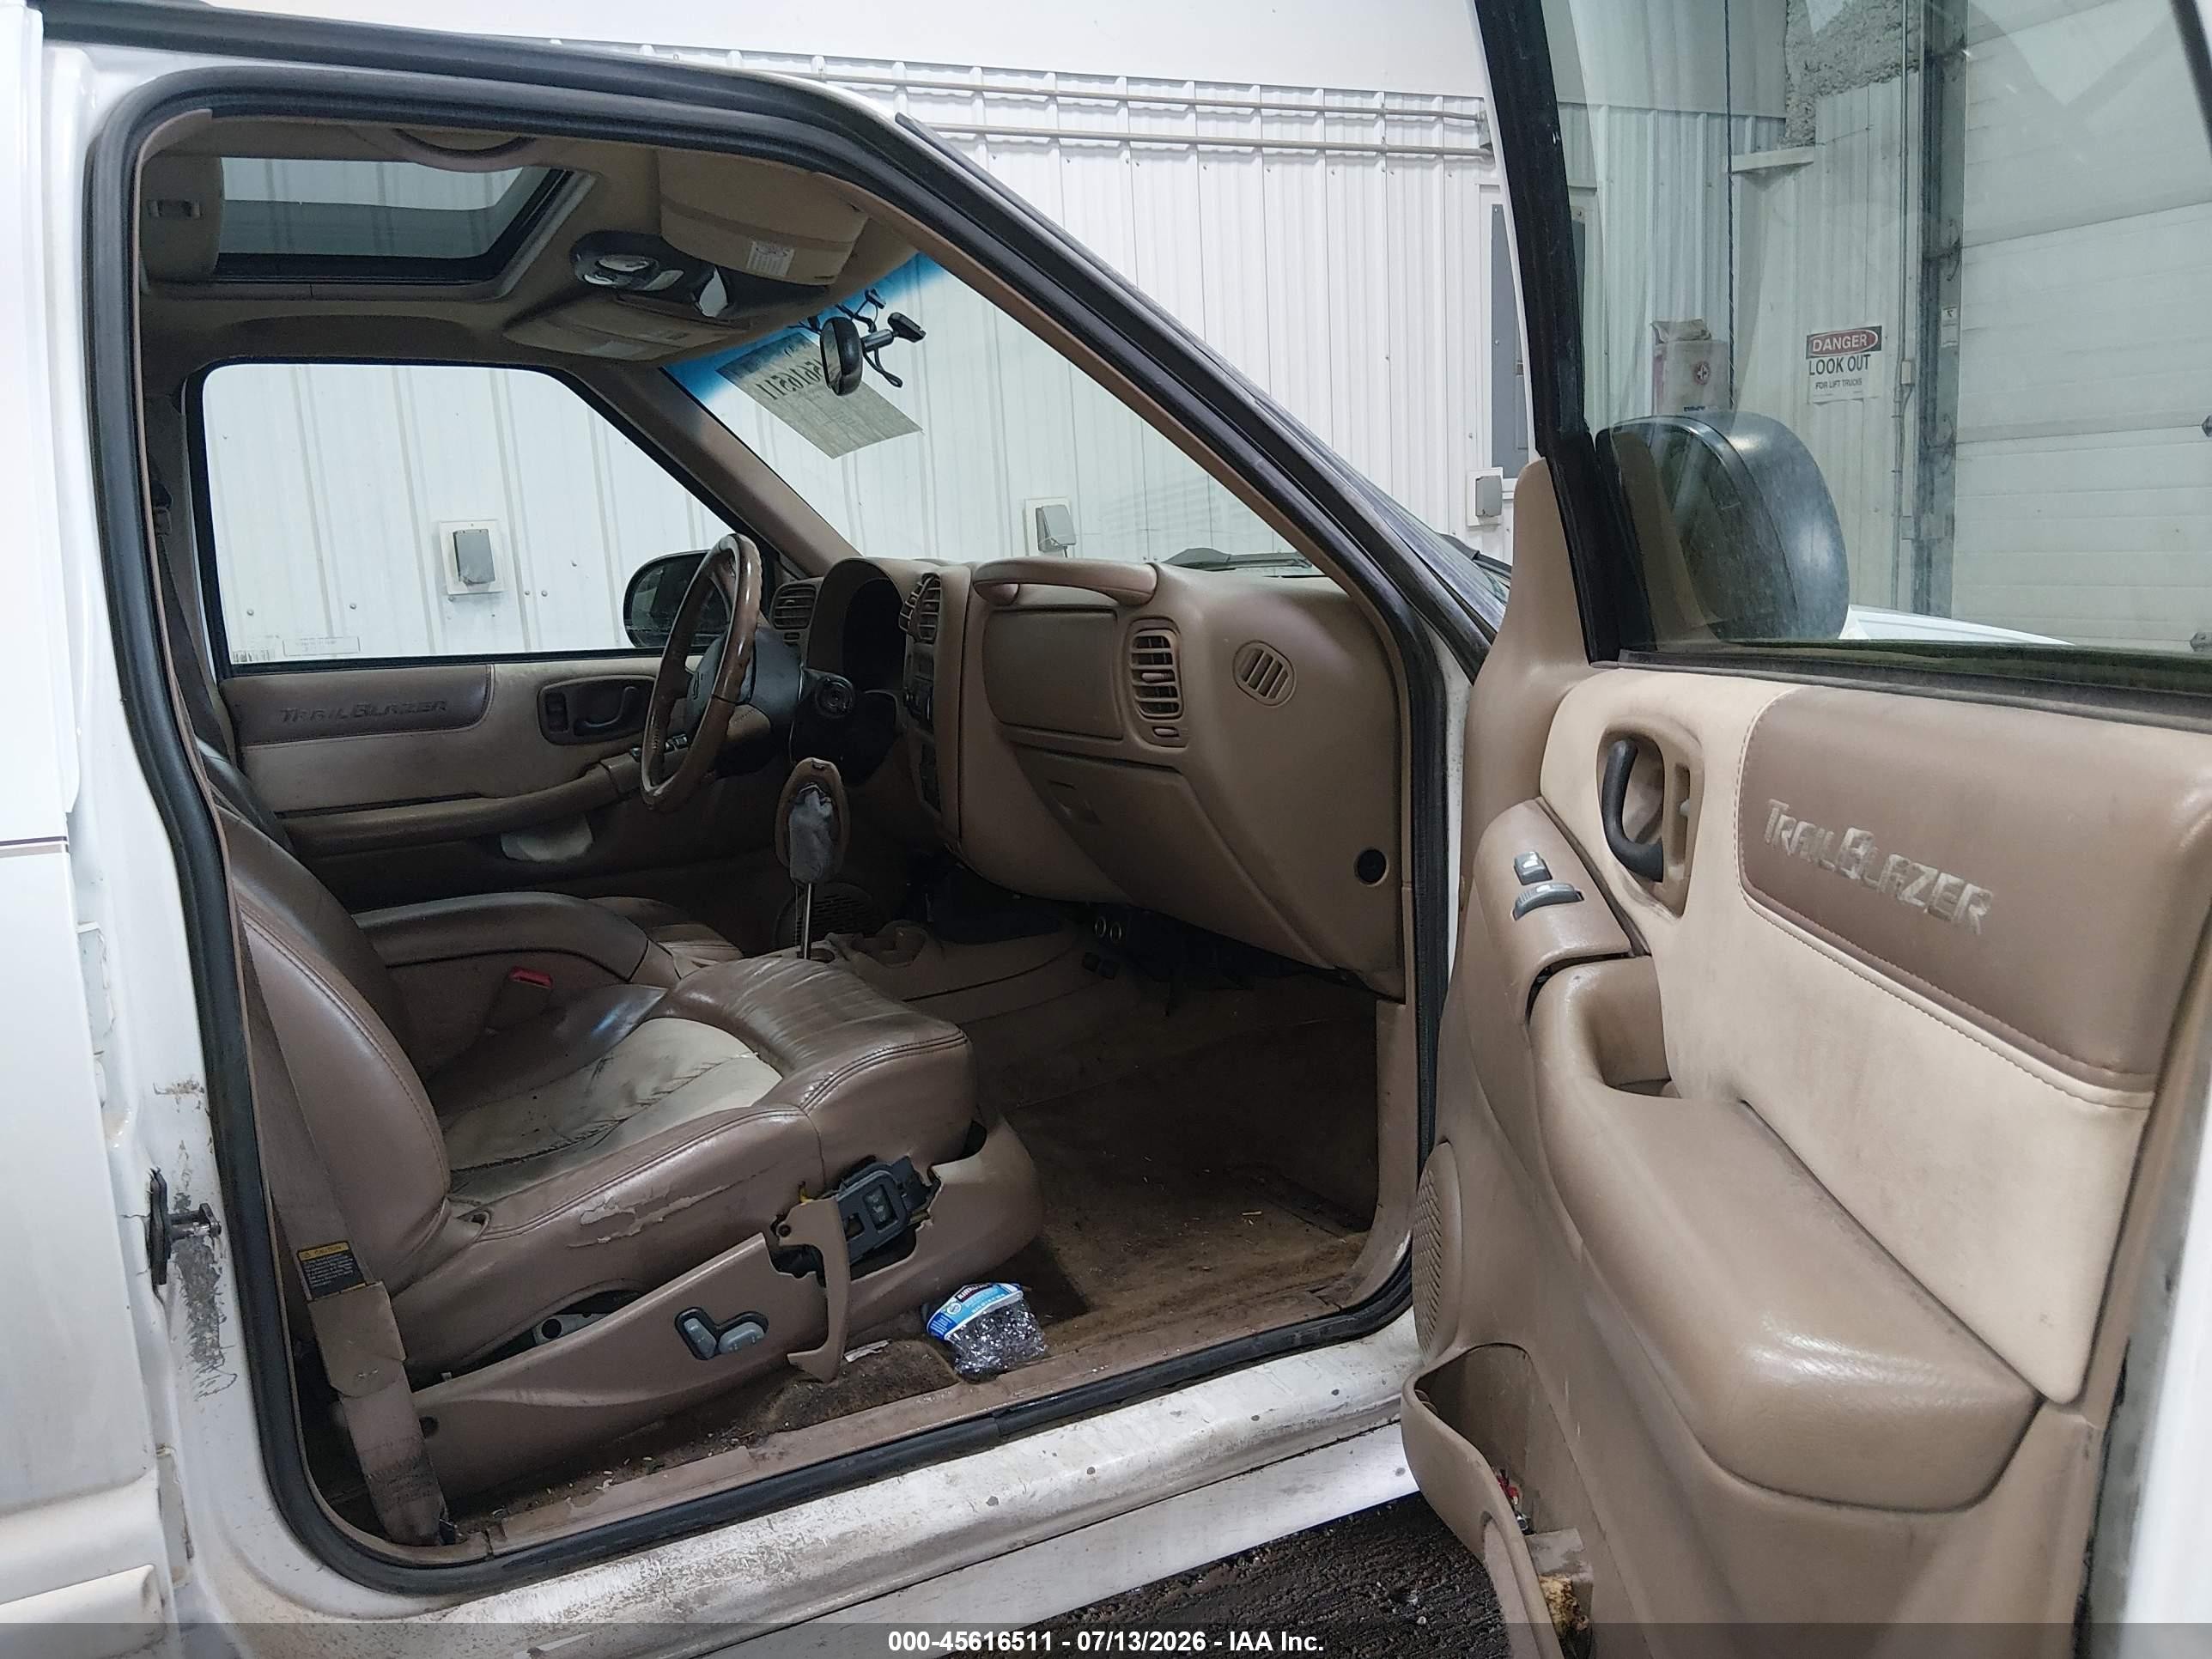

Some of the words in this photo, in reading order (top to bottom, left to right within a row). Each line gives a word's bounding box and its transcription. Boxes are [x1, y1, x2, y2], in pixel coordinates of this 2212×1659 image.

[1812, 333, 1868, 352] DANGER
[1808, 356, 1844, 376] LOOK
[1847, 354, 1871, 372] OUT
[1815, 381, 1828, 390] FOR
[1829, 380, 1841, 389] LIFT
[1842, 378, 1863, 387] TRUCKS
